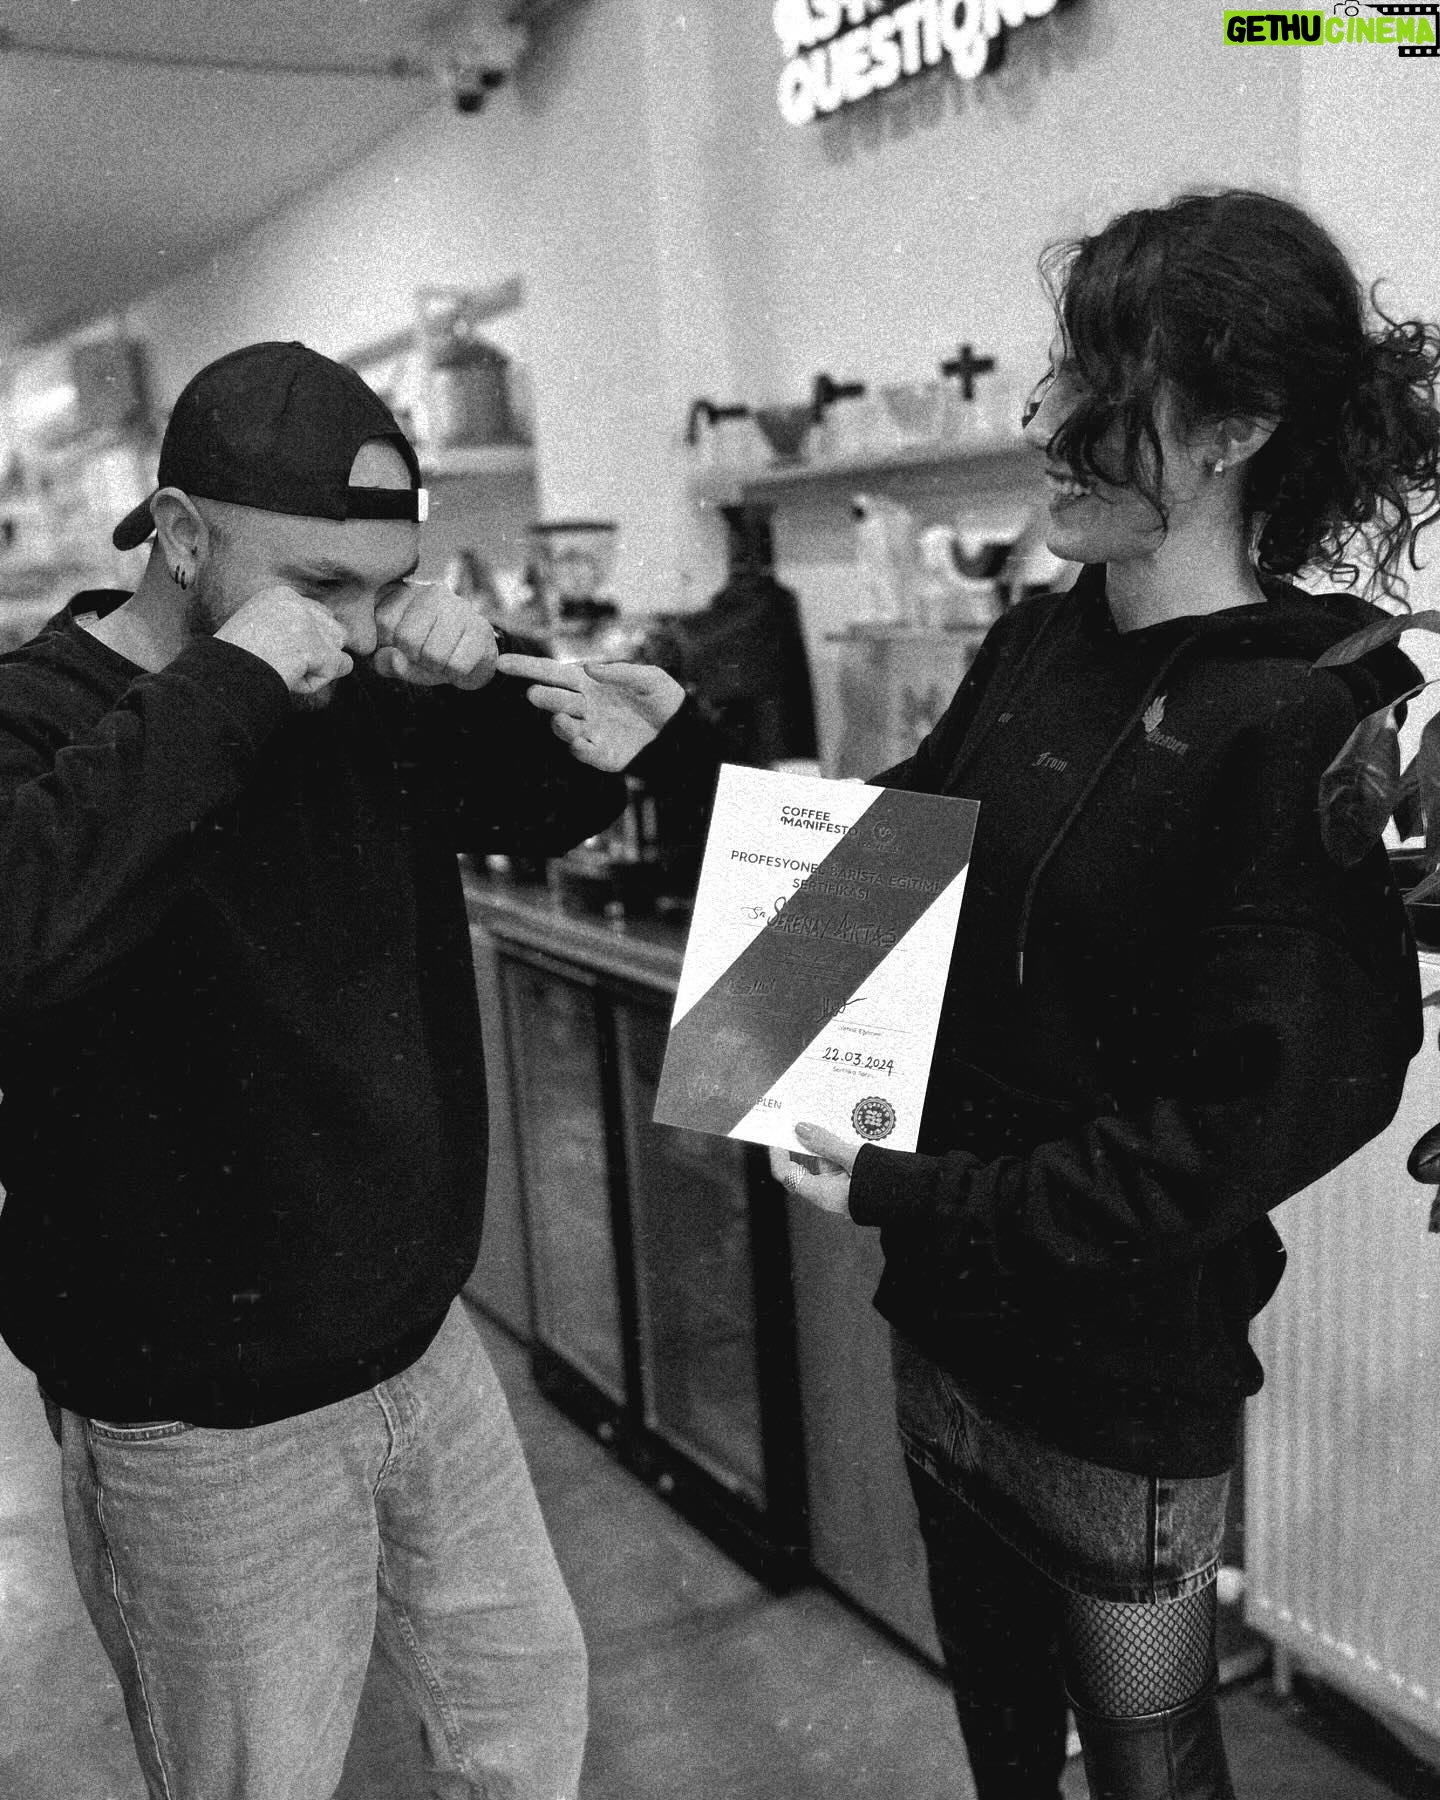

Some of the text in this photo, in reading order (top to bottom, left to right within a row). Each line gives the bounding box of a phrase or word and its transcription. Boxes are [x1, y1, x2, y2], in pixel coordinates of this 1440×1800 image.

[782, 805, 831, 822] COFFEE
[780, 815, 858, 836] MANIFESTO
[730, 850, 826, 876] PROFESYONEL
[822, 1046, 894, 1077] 22.03.2024
